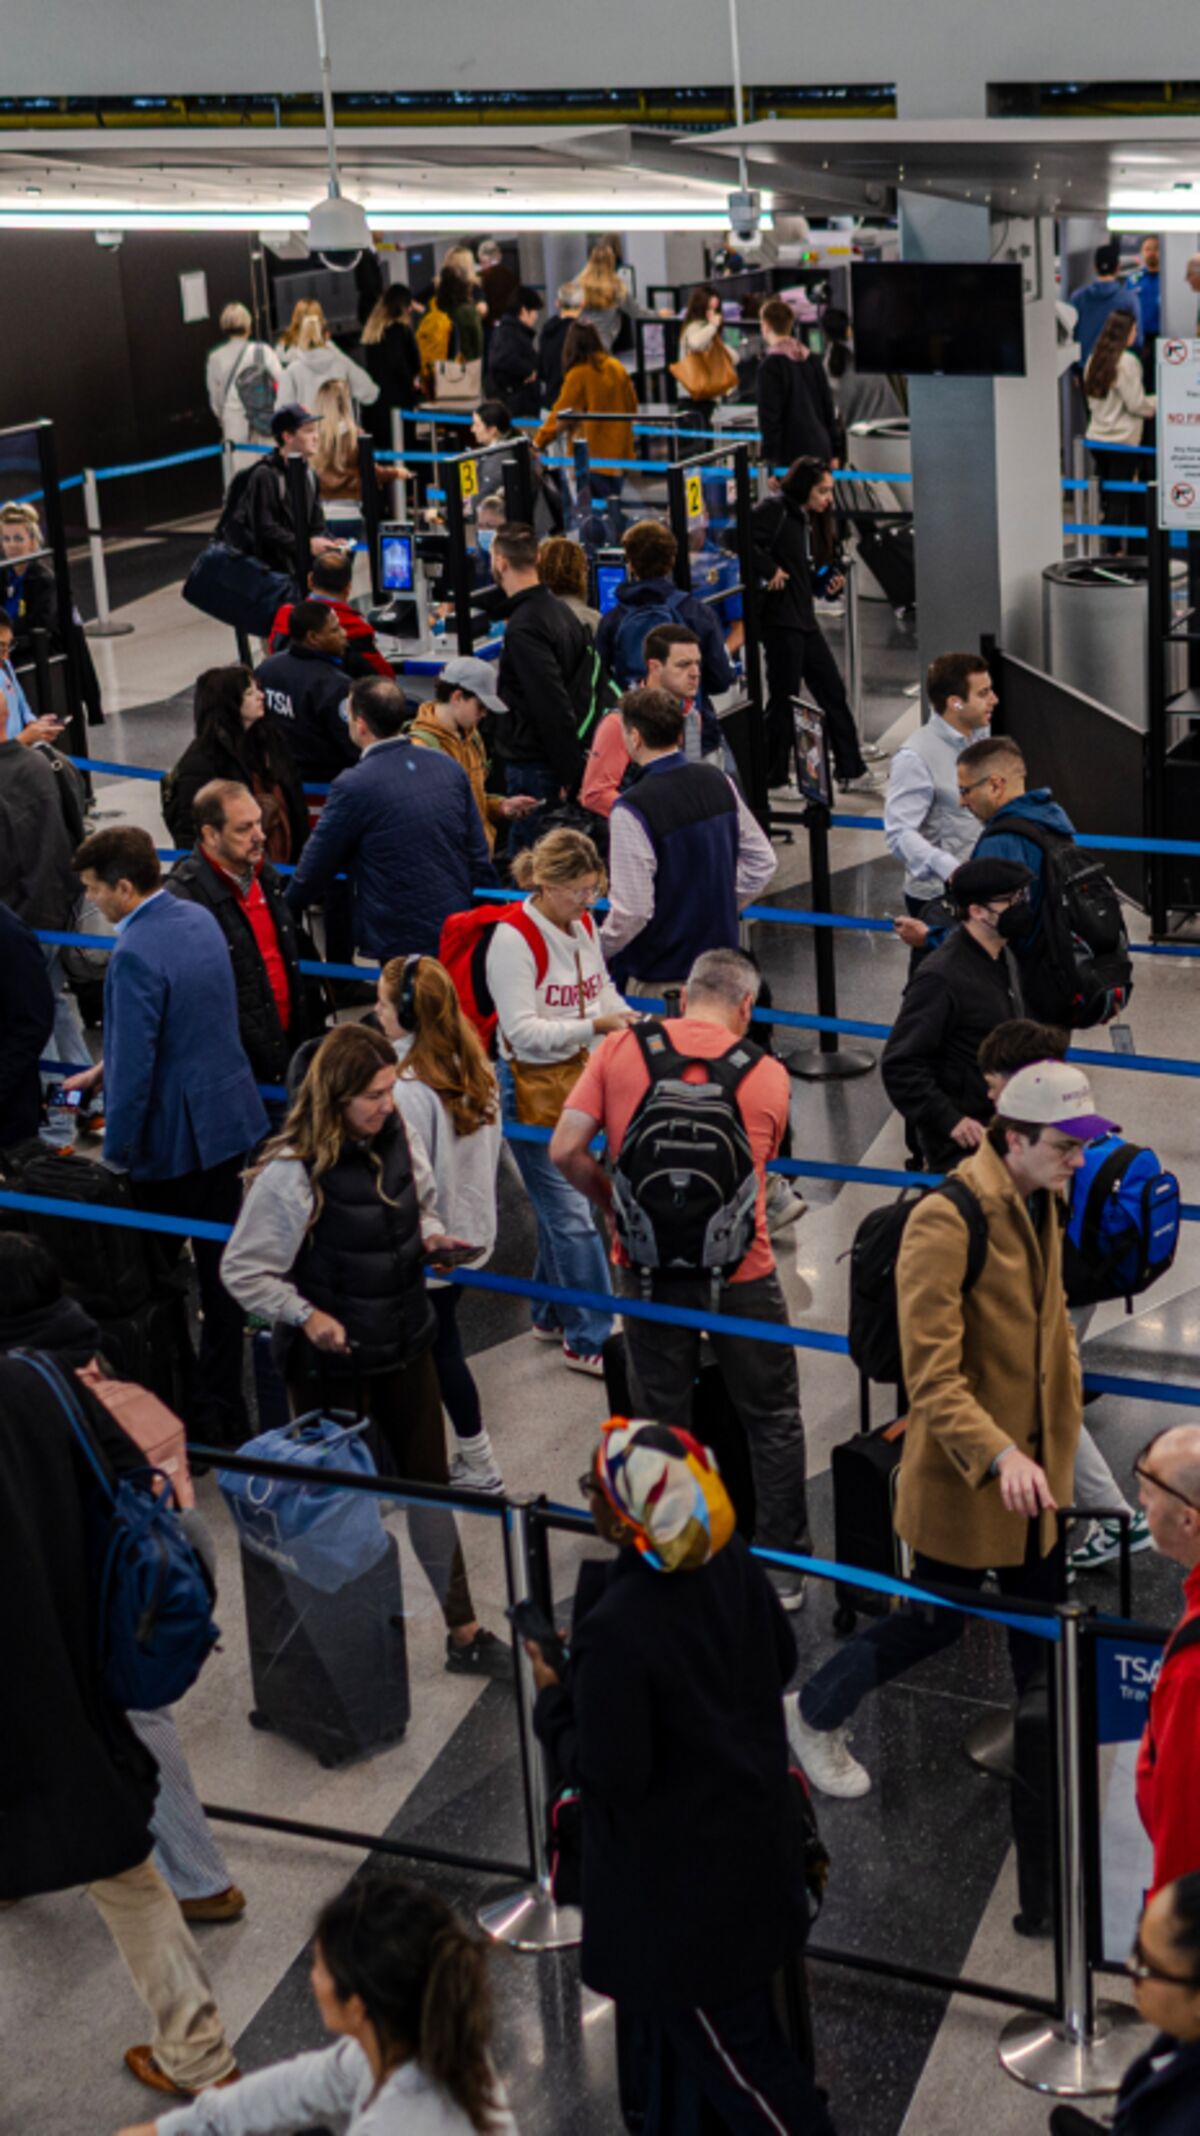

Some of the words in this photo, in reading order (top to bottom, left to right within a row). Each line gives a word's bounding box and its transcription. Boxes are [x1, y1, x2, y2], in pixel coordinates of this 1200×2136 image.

[463, 464, 474, 492] 3
[690, 481, 699, 511] 2
[265, 688, 295, 718] TSA
[1115, 1654, 1162, 1683] TSA
